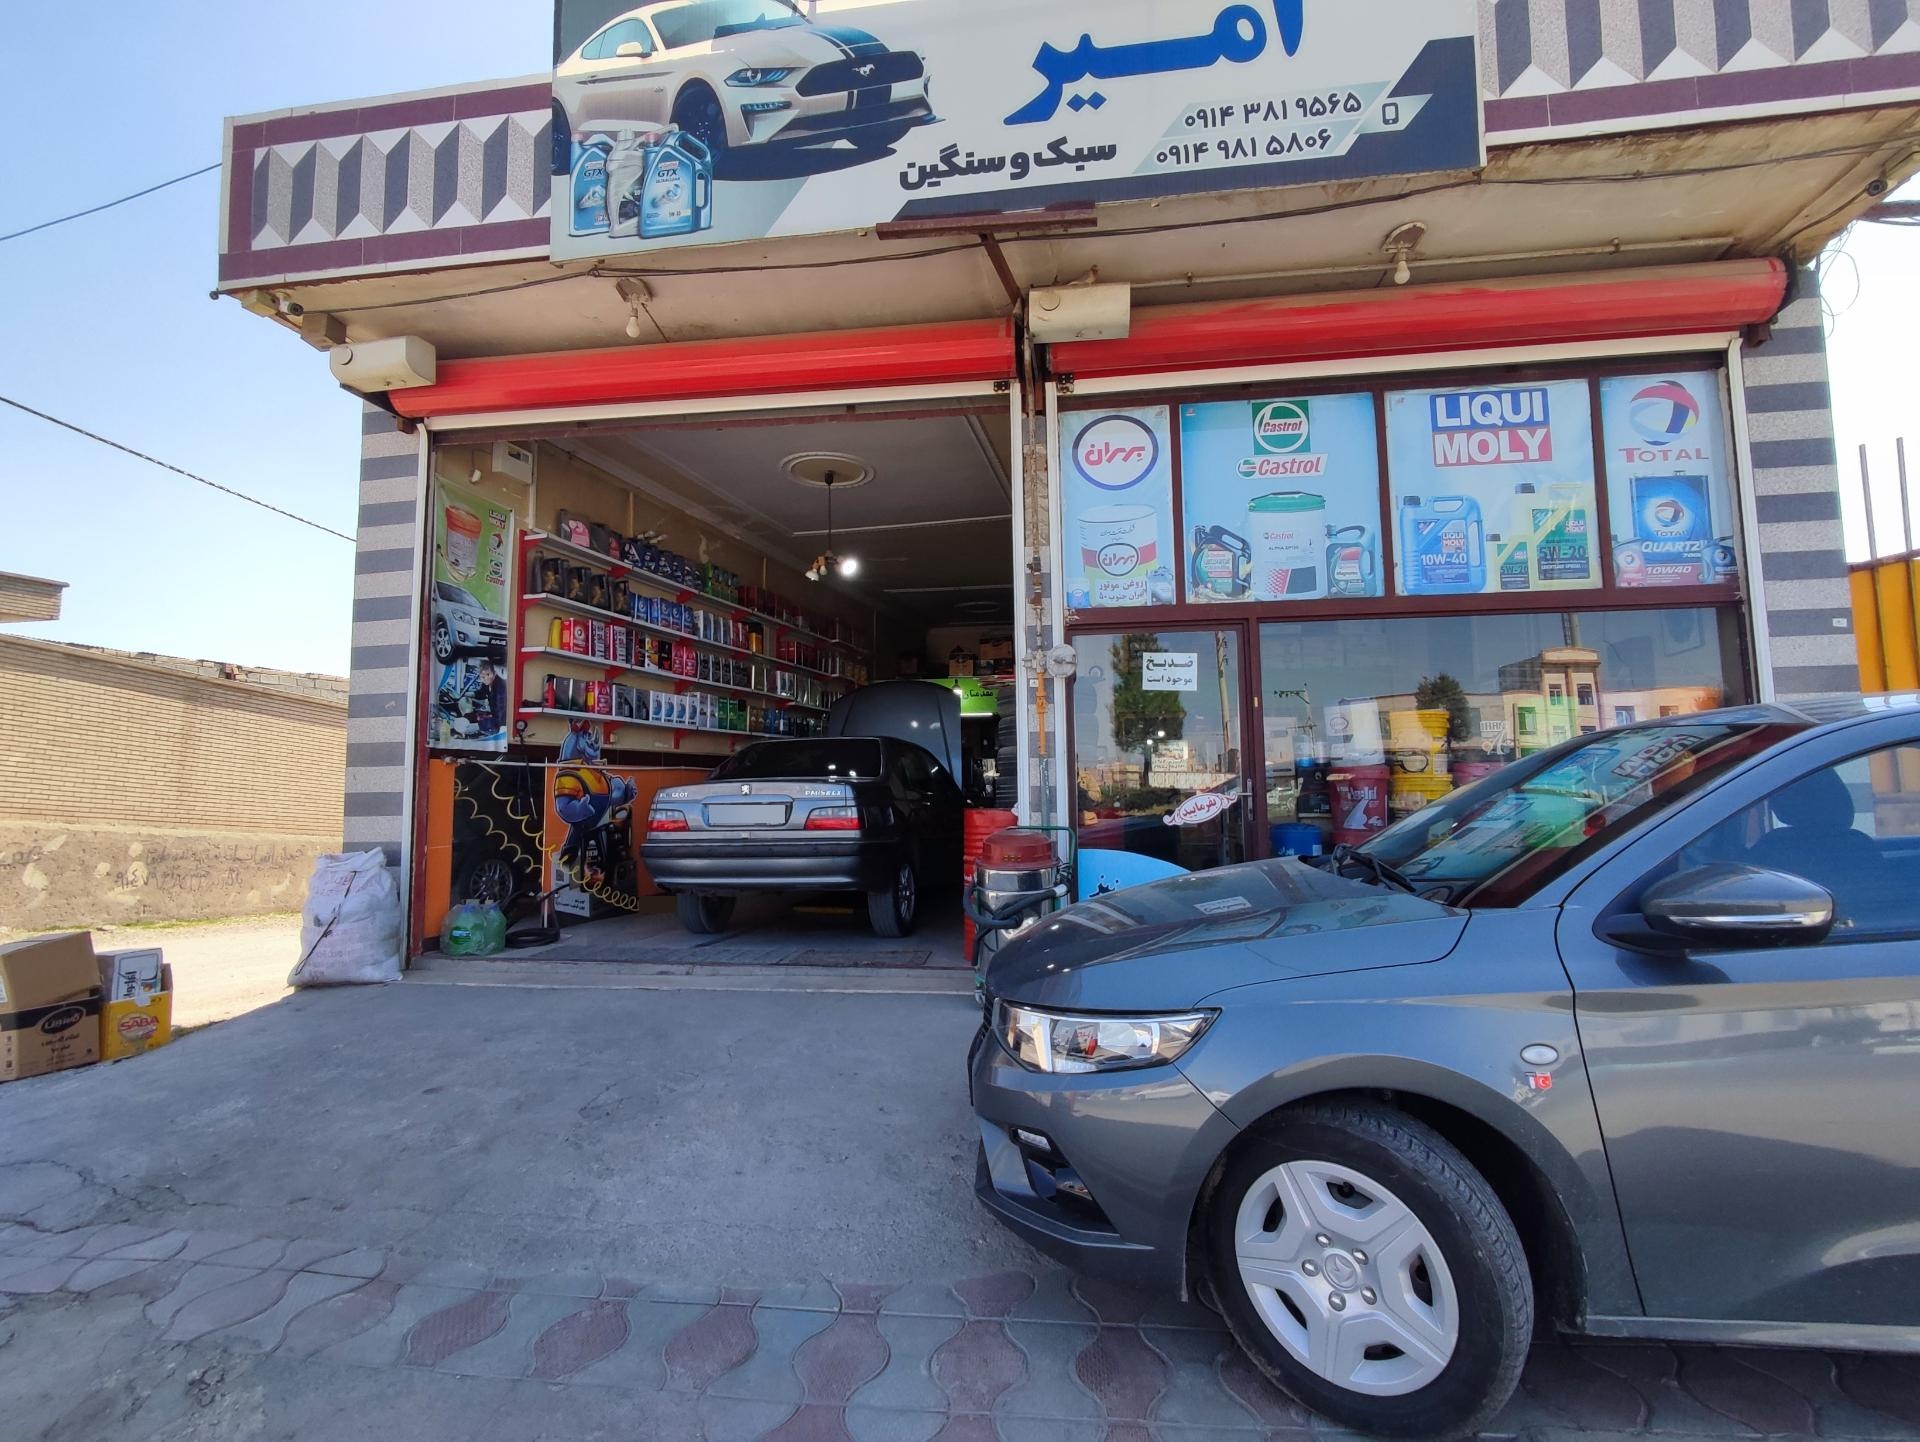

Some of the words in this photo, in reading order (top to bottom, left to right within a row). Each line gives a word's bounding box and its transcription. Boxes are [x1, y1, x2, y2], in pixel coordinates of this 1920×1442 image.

[1003, 0, 1303, 126] امیر
[1185, 106, 1234, 128] ۰۹۱۴
[1244, 100, 1287, 124] ۳۸۱
[1296, 92, 1361, 117] ۹۵۶۵
[1034, 136, 1117, 171] سبک
[1157, 142, 1208, 164] ۰۹۱۴
[1217, 137, 1256, 159] ۹۸۱
[1266, 129, 1331, 155] ۵۸۰۶
[657, 169, 678, 178] GTX
[899, 143, 1006, 190] سنگین
[1010, 152, 1030, 180] و
[1435, 391, 1545, 427] LIQUI
[1262, 420, 1303, 433] Castrol
[1434, 428, 1548, 465] MOLY
[1618, 446, 1710, 464] TOTAL
[1258, 456, 1321, 476] Castrol
[1641, 540, 1700, 553] QUARTZ
[1421, 553, 1467, 566] 10W-40
[1647, 565, 1692, 575] 10W40
[1146, 656, 1194, 671] ضدیخ
[1146, 675, 1164, 683] است
[1167, 676, 1192, 685] موجود
[118, 1016, 160, 1032] SABA
